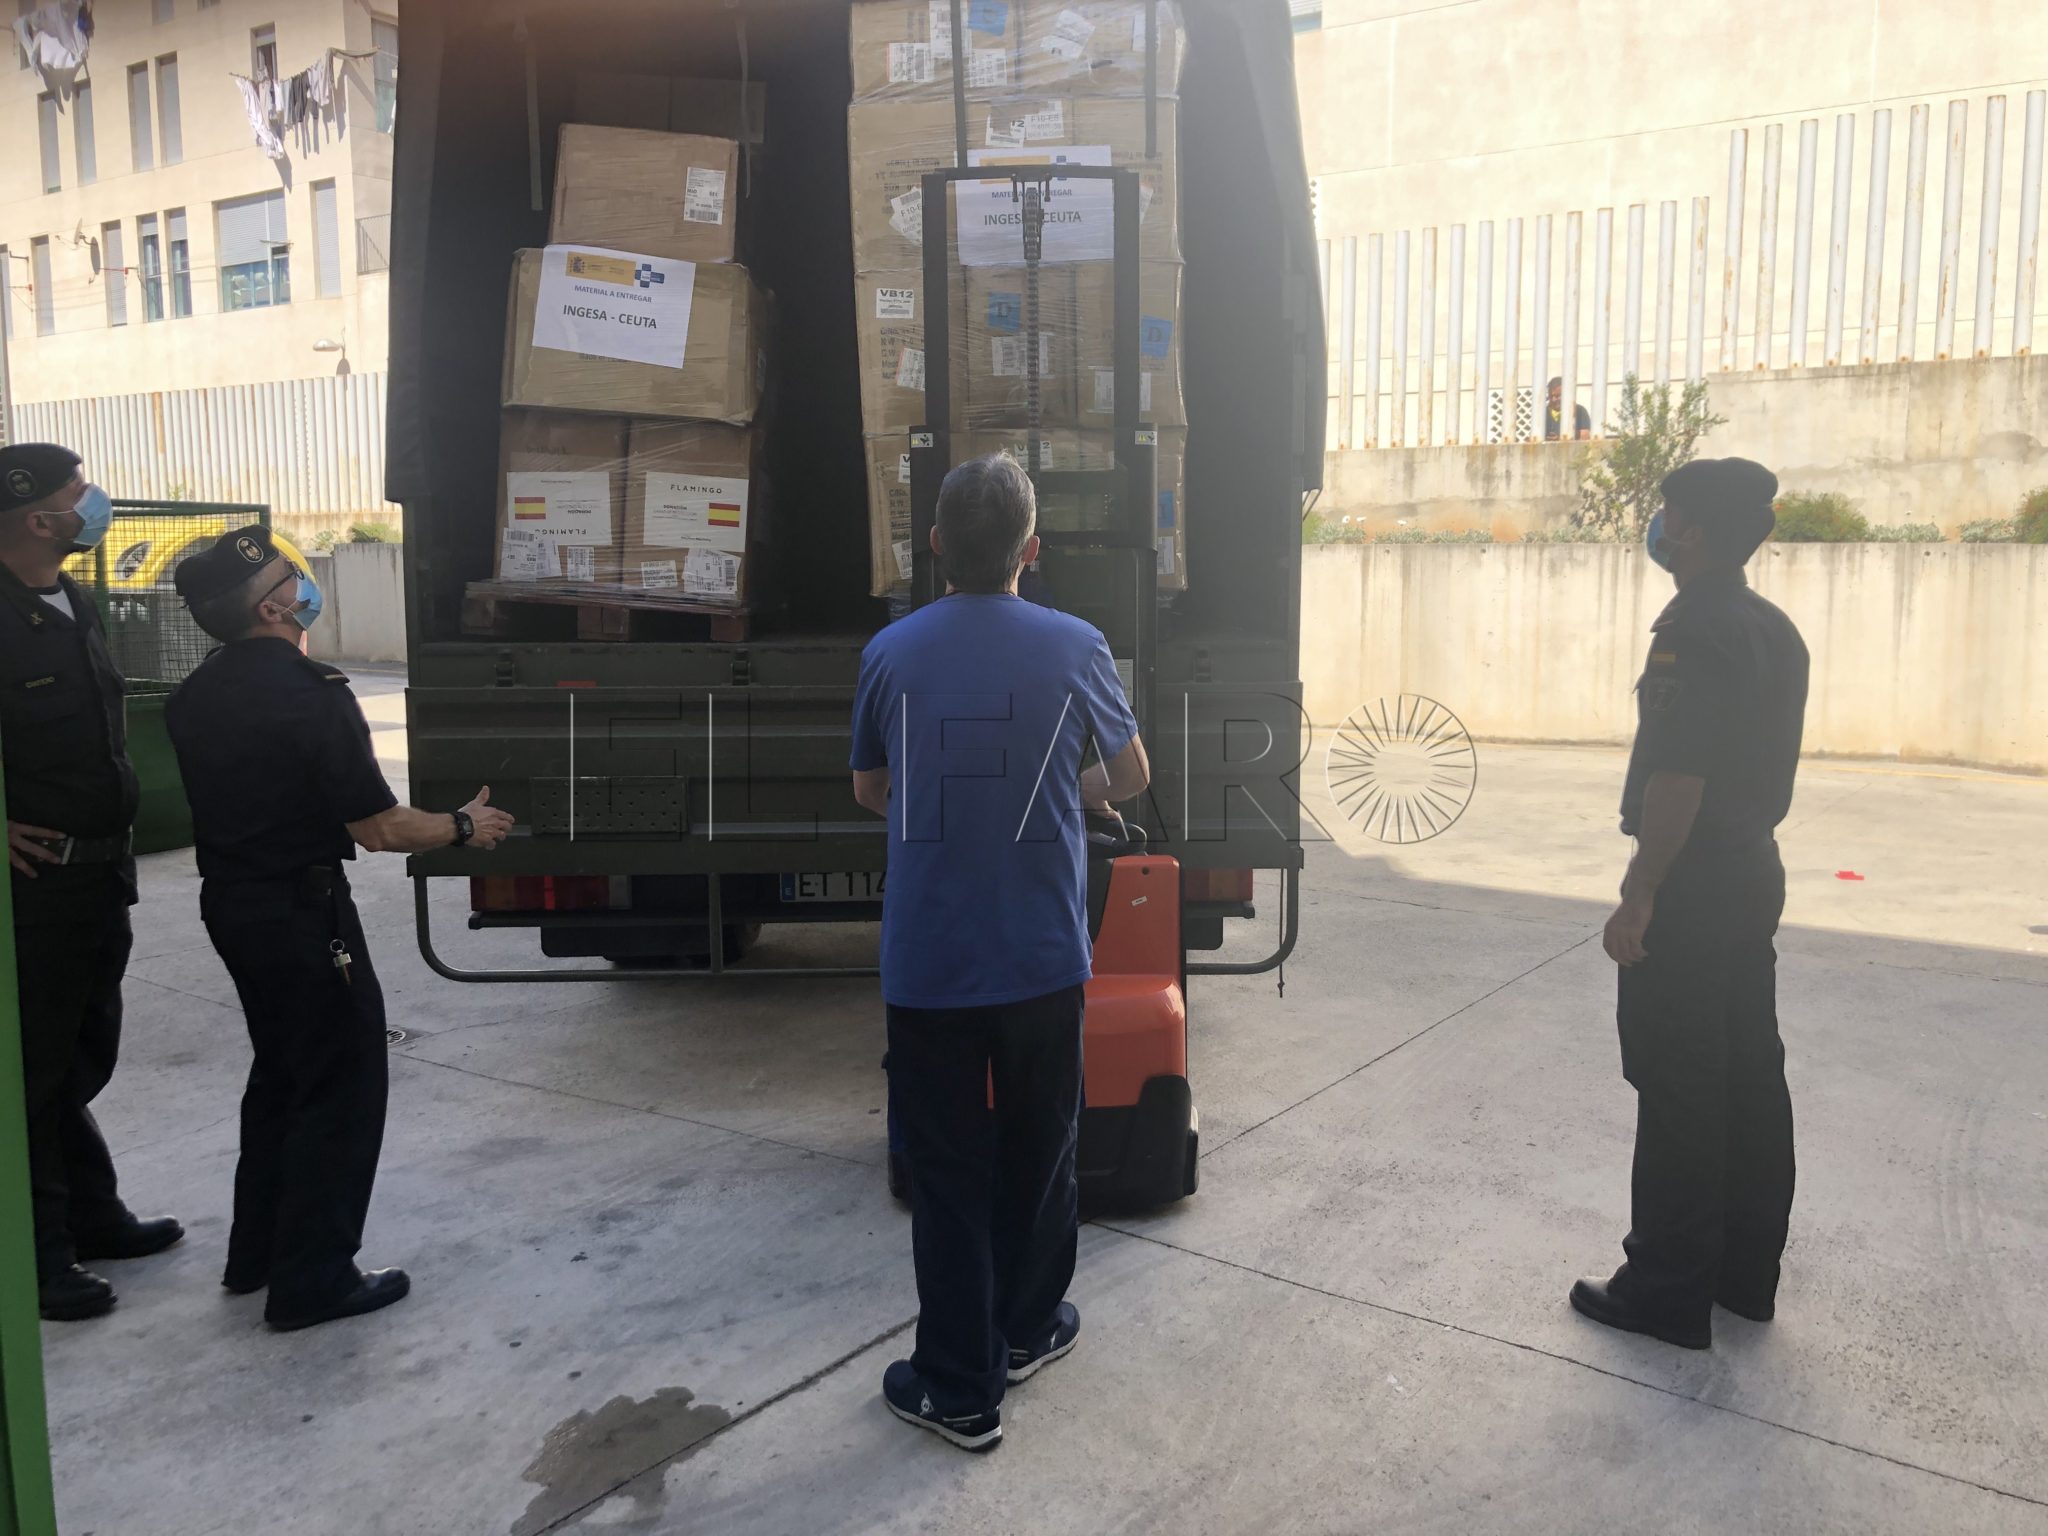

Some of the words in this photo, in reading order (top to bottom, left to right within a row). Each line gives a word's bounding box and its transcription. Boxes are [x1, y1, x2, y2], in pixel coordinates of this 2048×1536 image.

[984, 213, 1022, 226] INGES
[574, 284, 608, 297] MATERIAL
[609, 290, 616, 298] A
[616, 291, 653, 304] ENTREGAR
[880, 289, 913, 299] VB12
[563, 304, 608, 321] INGESA
[618, 313, 658, 330] CEUTA
[670, 484, 723, 495] FLAMINGO
